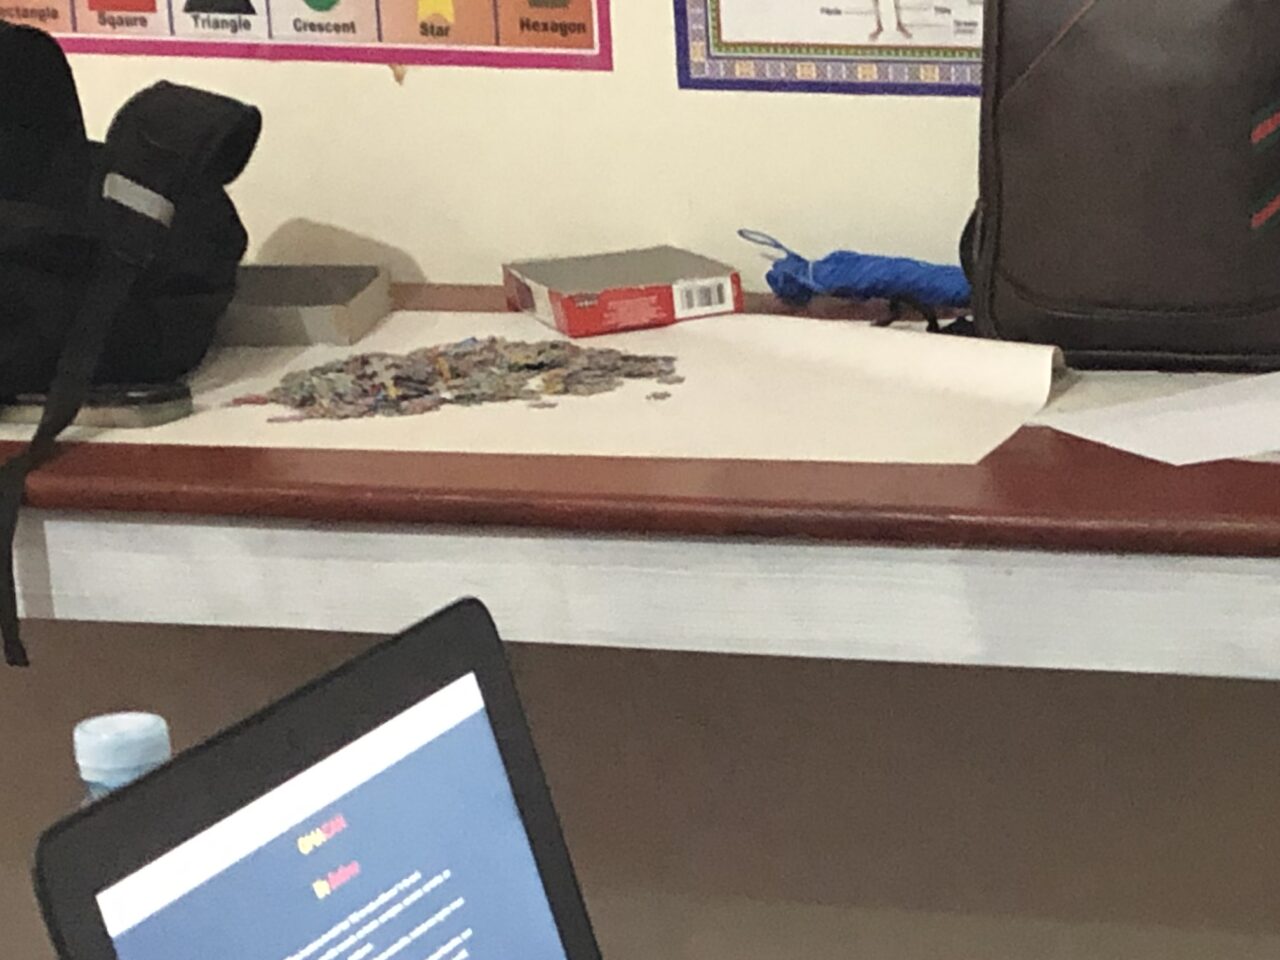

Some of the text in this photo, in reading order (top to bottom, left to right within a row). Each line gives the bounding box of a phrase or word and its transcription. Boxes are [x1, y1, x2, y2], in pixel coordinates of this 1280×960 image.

[191, 15, 252, 34] Triangle
[292, 18, 357, 34] Crescent
[419, 21, 450, 37] Star
[519, 17, 587, 37] Hexagon
